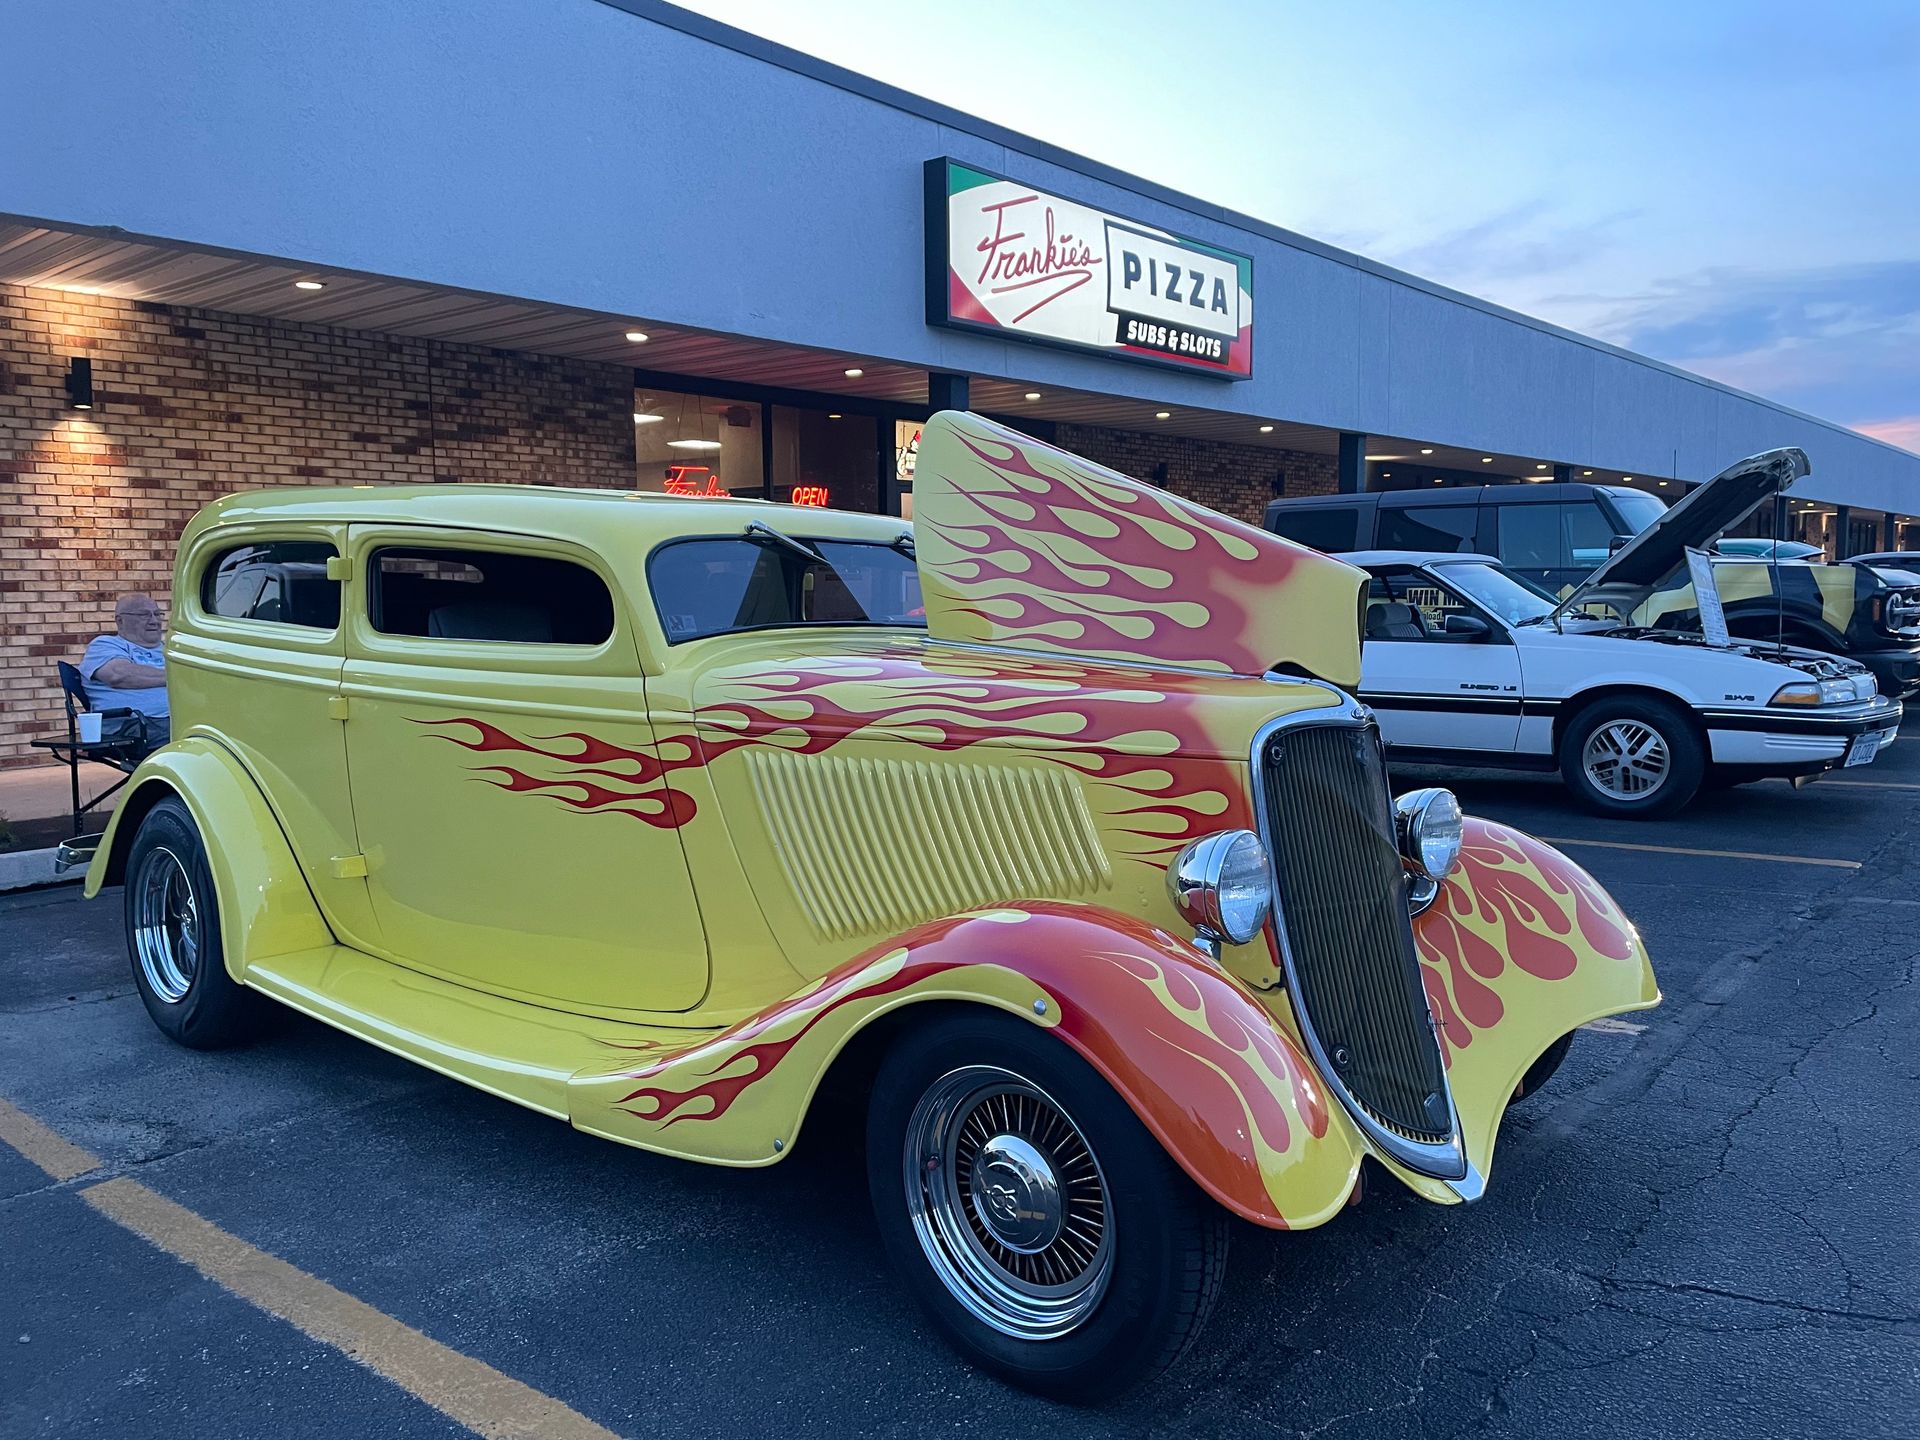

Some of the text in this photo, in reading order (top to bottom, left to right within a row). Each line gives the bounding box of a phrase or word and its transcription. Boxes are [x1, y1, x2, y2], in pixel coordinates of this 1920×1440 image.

[977, 195, 1102, 284] Frankie's
[1123, 250, 1228, 315] PIZZA
[1127, 320, 1167, 346] SUBS
[1180, 332, 1222, 357] SLOTS
[792, 487, 828, 506] OPEN
[1409, 590, 1438, 606] WIN
